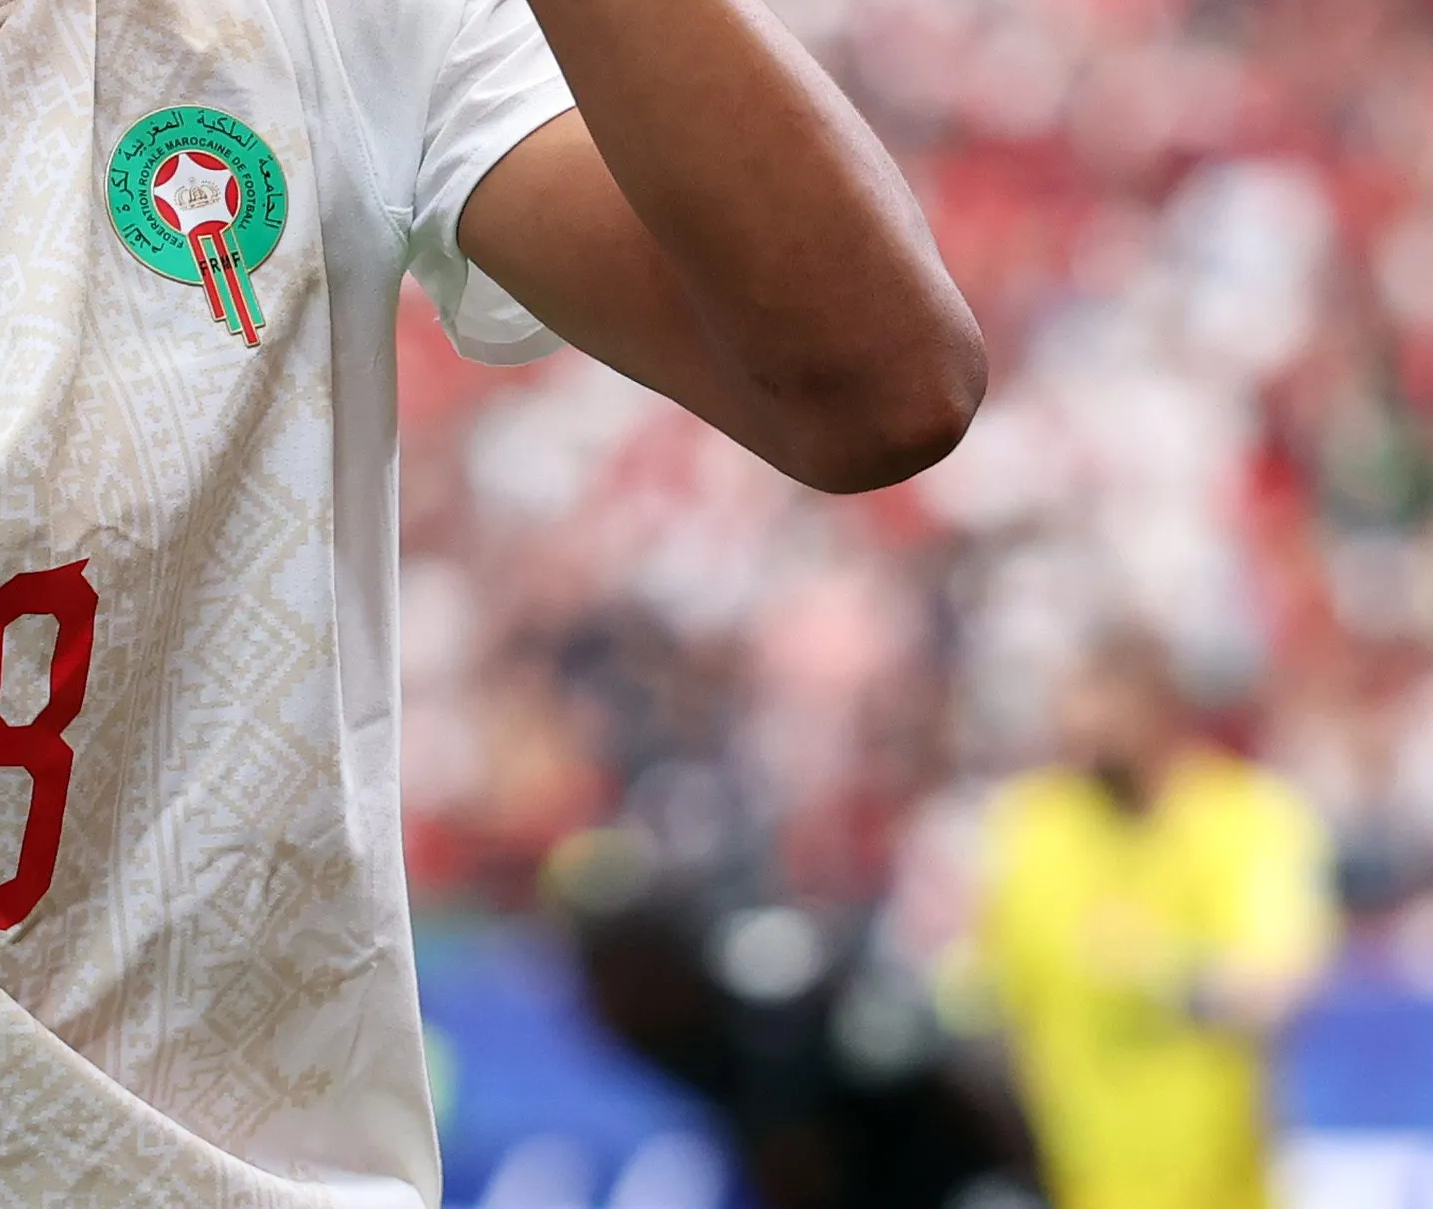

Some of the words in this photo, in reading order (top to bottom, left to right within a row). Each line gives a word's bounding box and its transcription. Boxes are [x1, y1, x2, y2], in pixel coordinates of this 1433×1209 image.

[118, 110, 184, 161] المغربية
[165, 136, 232, 159] MAROCAINE
[197, 109, 257, 151] الملكية
[139, 146, 165, 186] ROYALE
[231, 156, 245, 172] DE
[110, 168, 135, 214] لكرة
[238, 172, 257, 230] FOOTBALL
[258, 155, 284, 229] الجامعة
[137, 189, 184, 249] FEDERATION
[199, 251, 242, 277] FRMF
